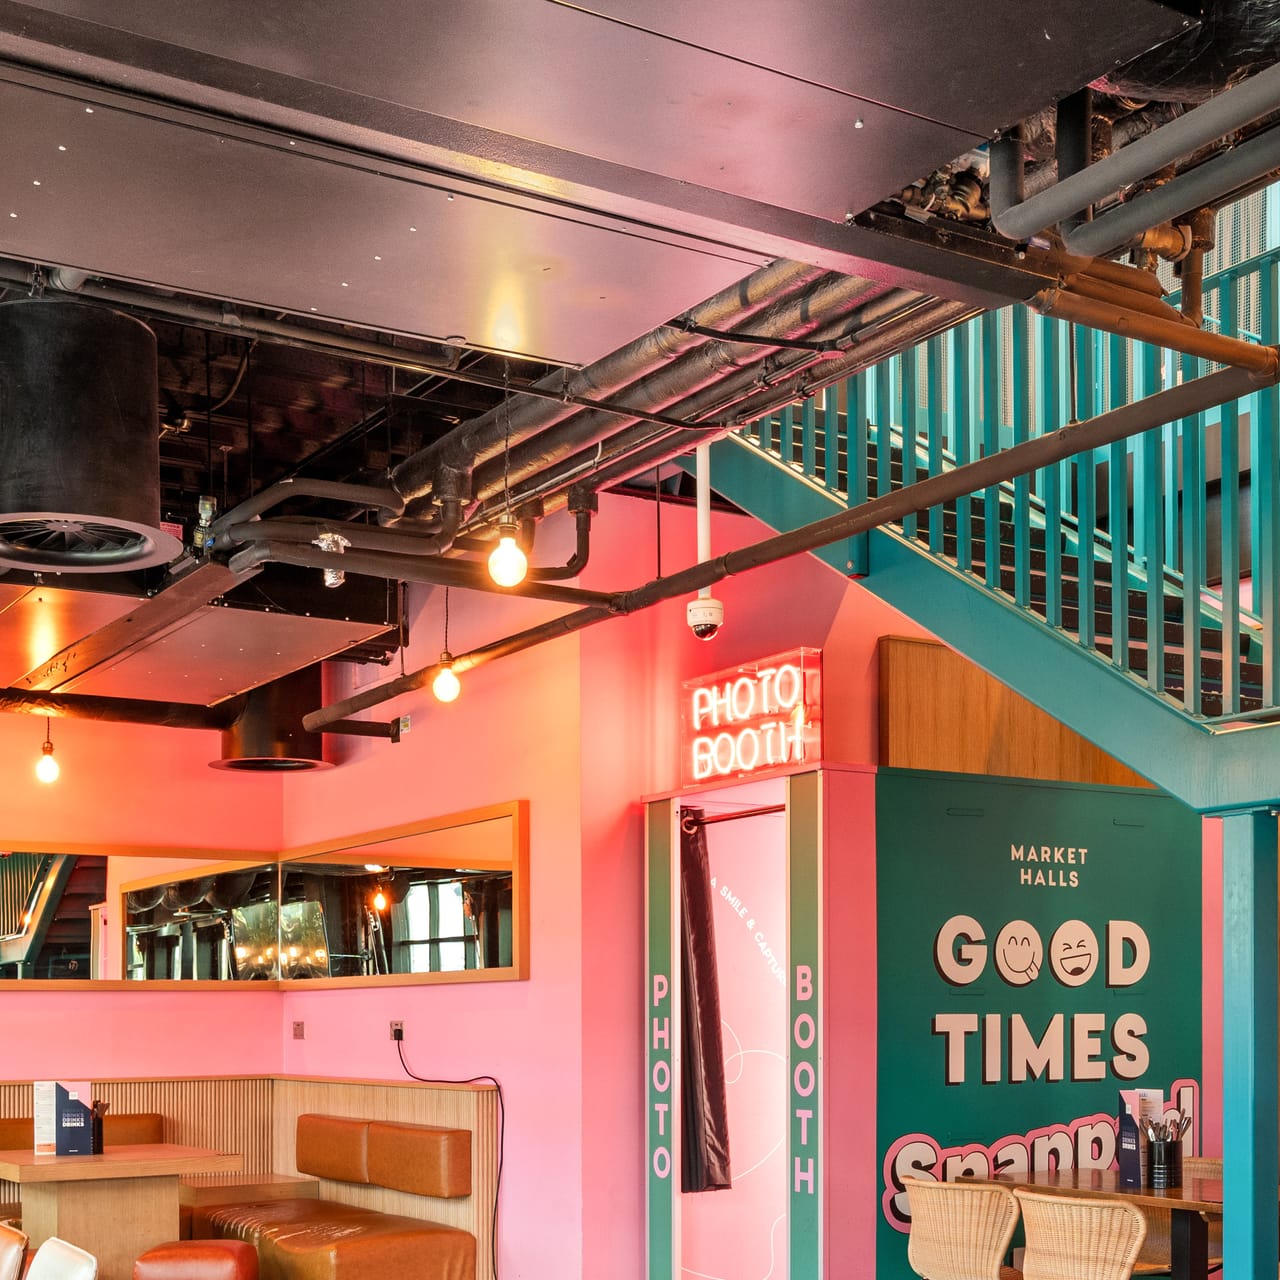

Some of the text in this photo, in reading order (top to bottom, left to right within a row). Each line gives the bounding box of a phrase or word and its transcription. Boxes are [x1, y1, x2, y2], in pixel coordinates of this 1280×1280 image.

[692, 664, 801, 730] PHOTO
[692, 705, 804, 779] BOOTH
[1010, 843, 1088, 865] MARKET
[1019, 867, 1080, 888] HALLS
[720, 885, 748, 918] SMILE
[746, 918, 756, 931] &
[754, 931, 786, 989] CAPTUR
[933, 914, 1151, 989] GOOD
[652, 974, 671, 1179] PHOTO
[794, 965, 816, 1194] BOOTH
[931, 1013, 1151, 1086] TIMES
[888, 1083, 1197, 1225] Snappd
